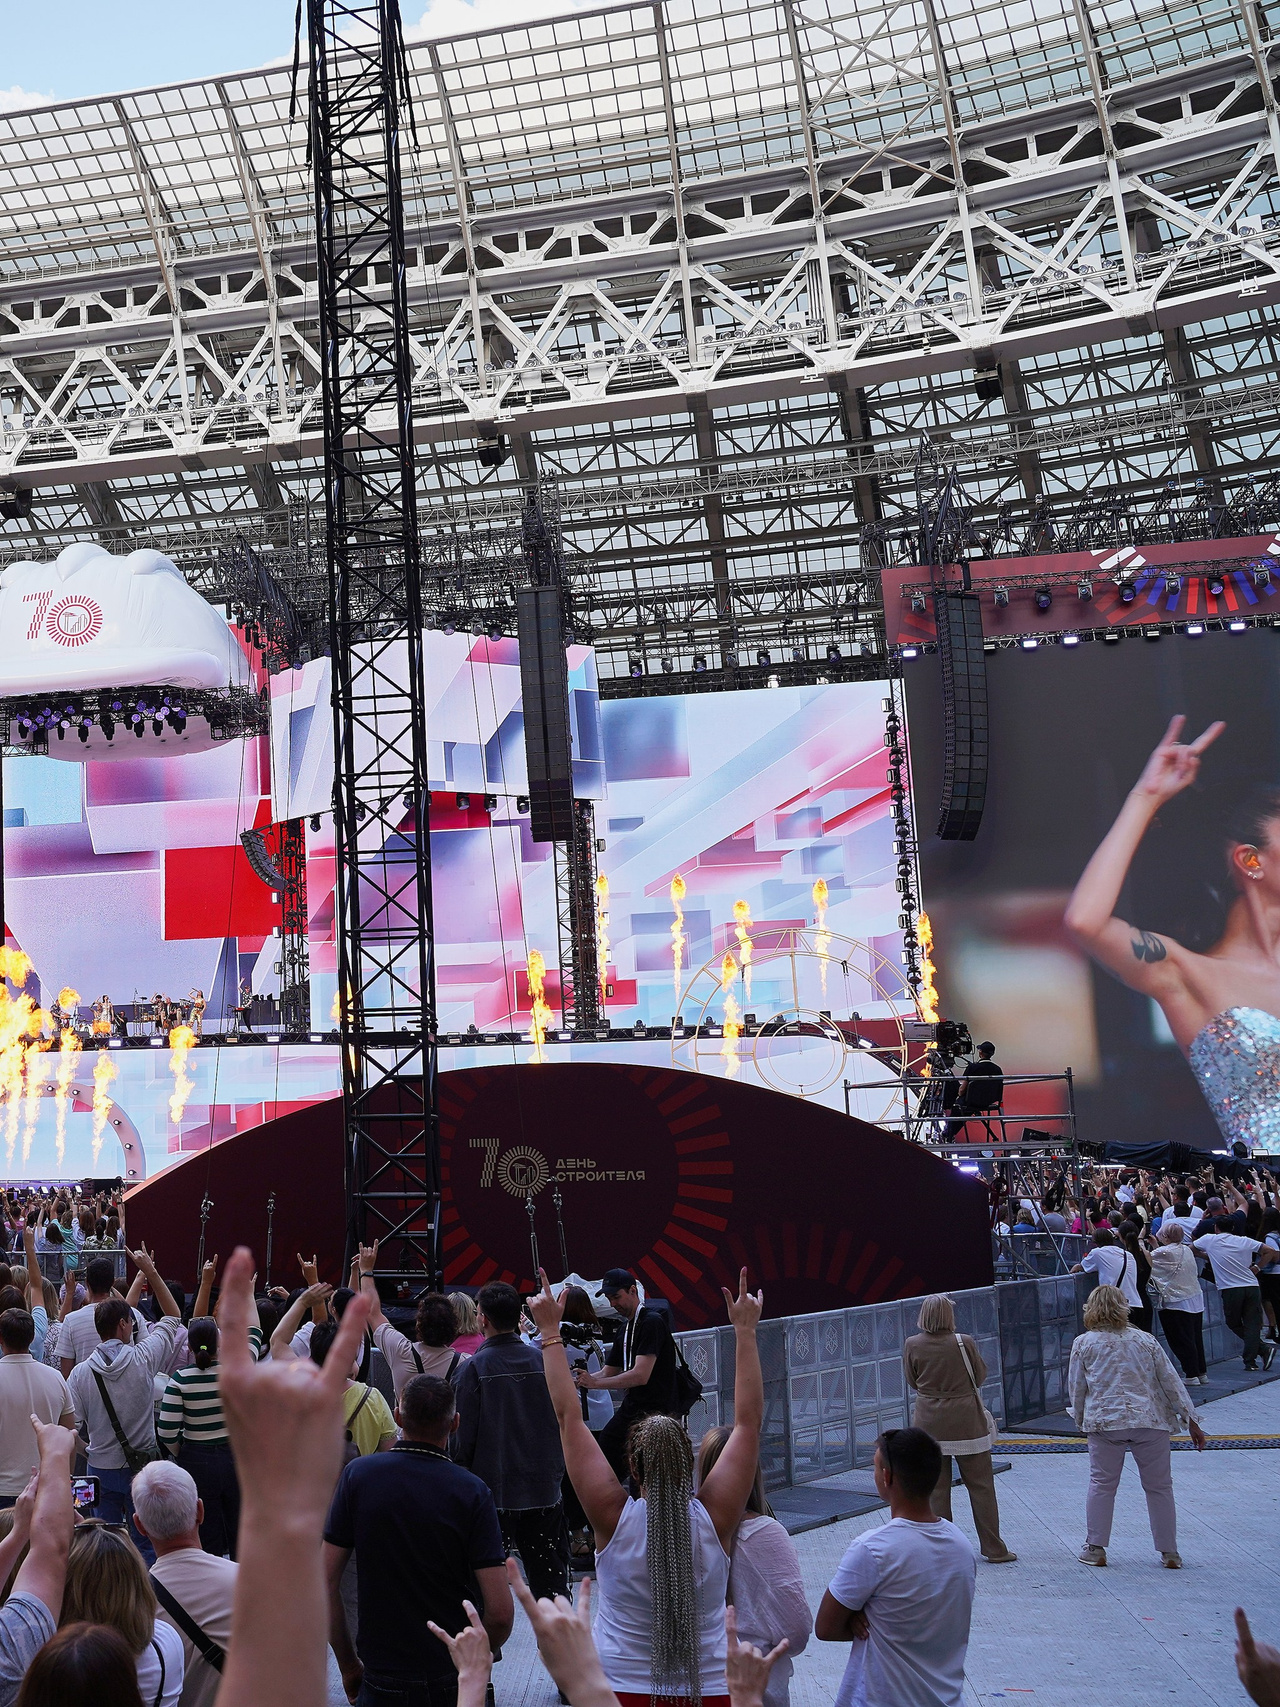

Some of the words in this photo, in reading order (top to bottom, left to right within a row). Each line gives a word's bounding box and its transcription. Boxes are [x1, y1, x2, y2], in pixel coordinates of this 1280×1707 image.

[469, 1138, 549, 1198] 70
[555, 1158, 597, 1169] ДЕНЬ
[556, 1170, 646, 1182] СТРОИТЕЛЯ
